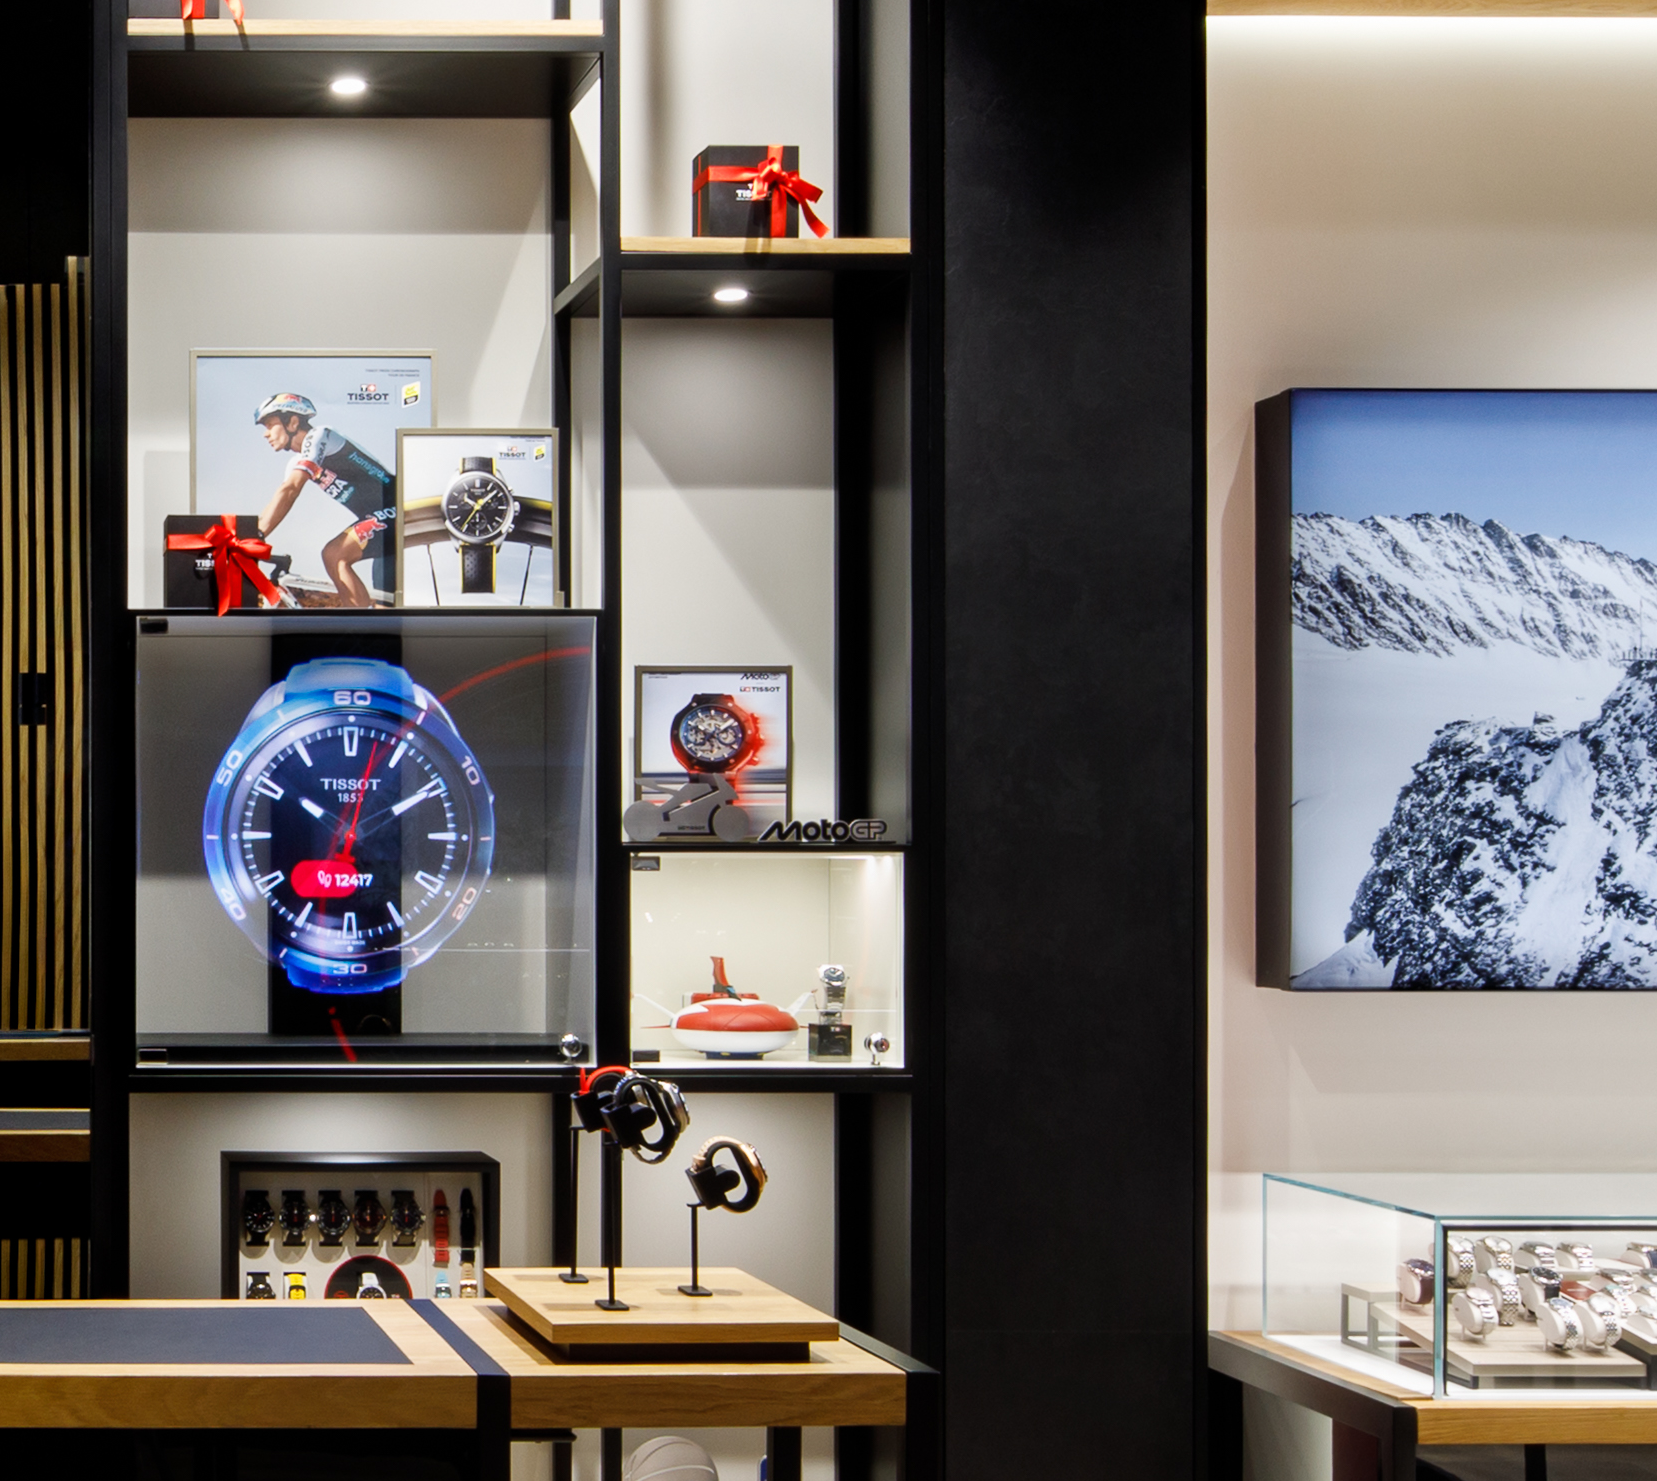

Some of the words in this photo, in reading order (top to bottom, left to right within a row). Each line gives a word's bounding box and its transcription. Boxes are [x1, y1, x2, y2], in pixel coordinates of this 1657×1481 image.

[347, 393, 389, 401] TISSOT
[373, 506, 396, 521] BO
[334, 691, 371, 706] 60
[217, 749, 243, 787] 50
[461, 756, 481, 786] 10
[320, 778, 381, 791] TISSOT
[757, 819, 887, 842] MotoGP
[335, 873, 374, 887] 12417
[219, 888, 247, 920] 40
[452, 887, 478, 921] 20
[333, 963, 367, 974] 30
